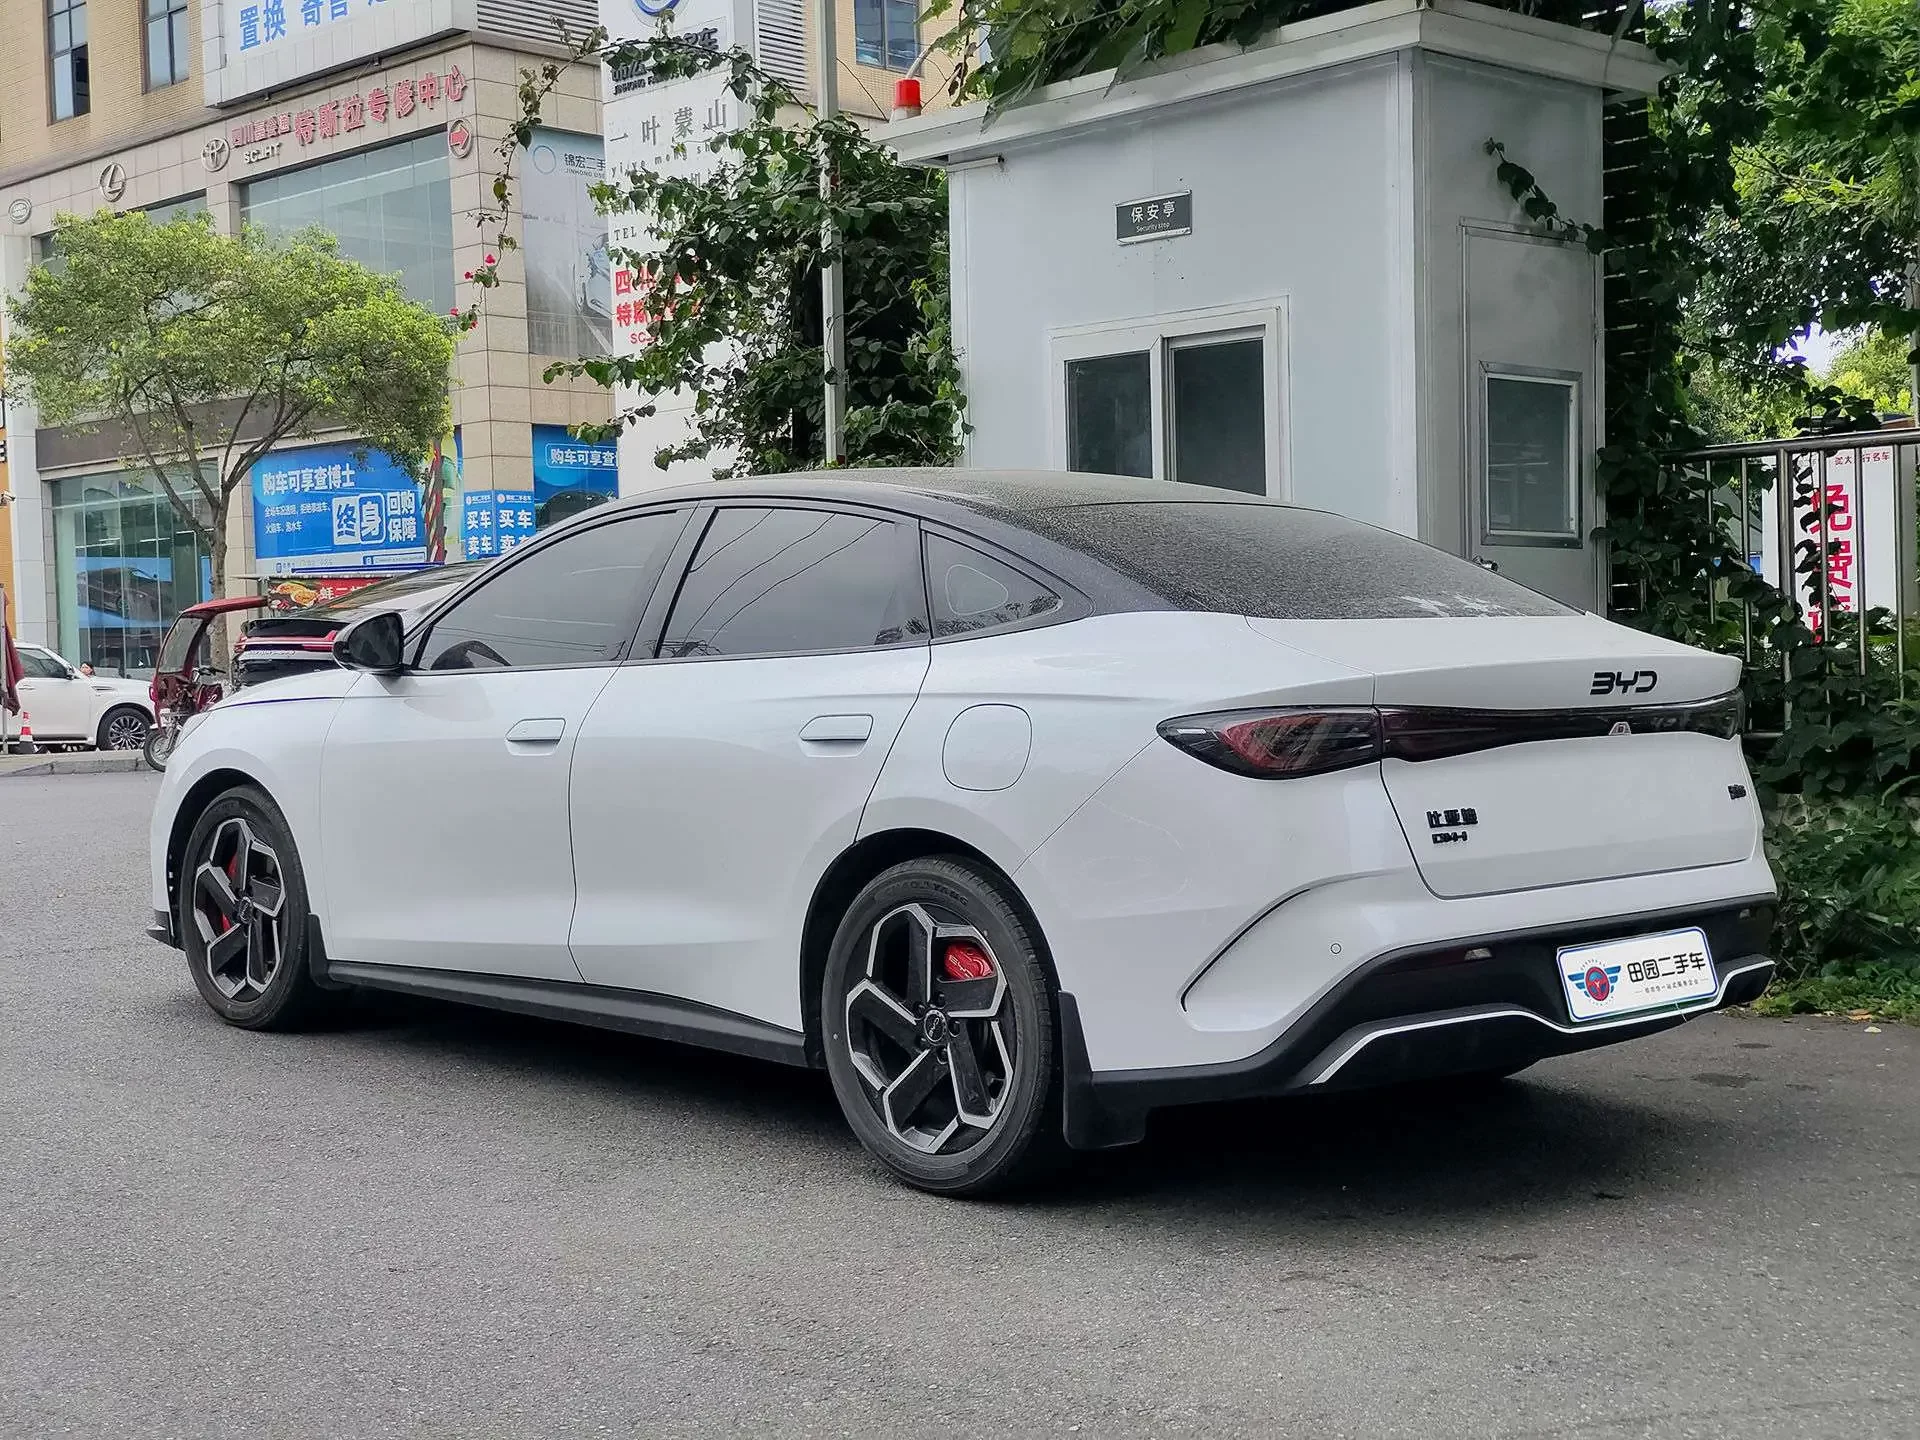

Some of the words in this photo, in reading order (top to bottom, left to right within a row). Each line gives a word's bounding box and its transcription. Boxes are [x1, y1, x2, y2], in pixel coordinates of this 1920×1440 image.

[240, 0, 286, 51] 置换
[294, 65, 466, 145] 特斯拉专修中心
[609, 98, 728, 146] 一叶蒙山
[1130, 200, 1175, 224] 保安亭
[613, 226, 637, 241] TEL
[550, 448, 618, 467] 购车可享查
[262, 463, 355, 496] 购车可享查博士
[387, 490, 415, 516] 回购
[336, 501, 382, 538] 终身
[388, 517, 417, 543] 保障
[466, 509, 492, 530] 买车
[500, 509, 533, 529] 买车
[468, 534, 493, 555] 卖车
[1590, 671, 1657, 694] BYD
[1627, 952, 1706, 982] 田园二手车
